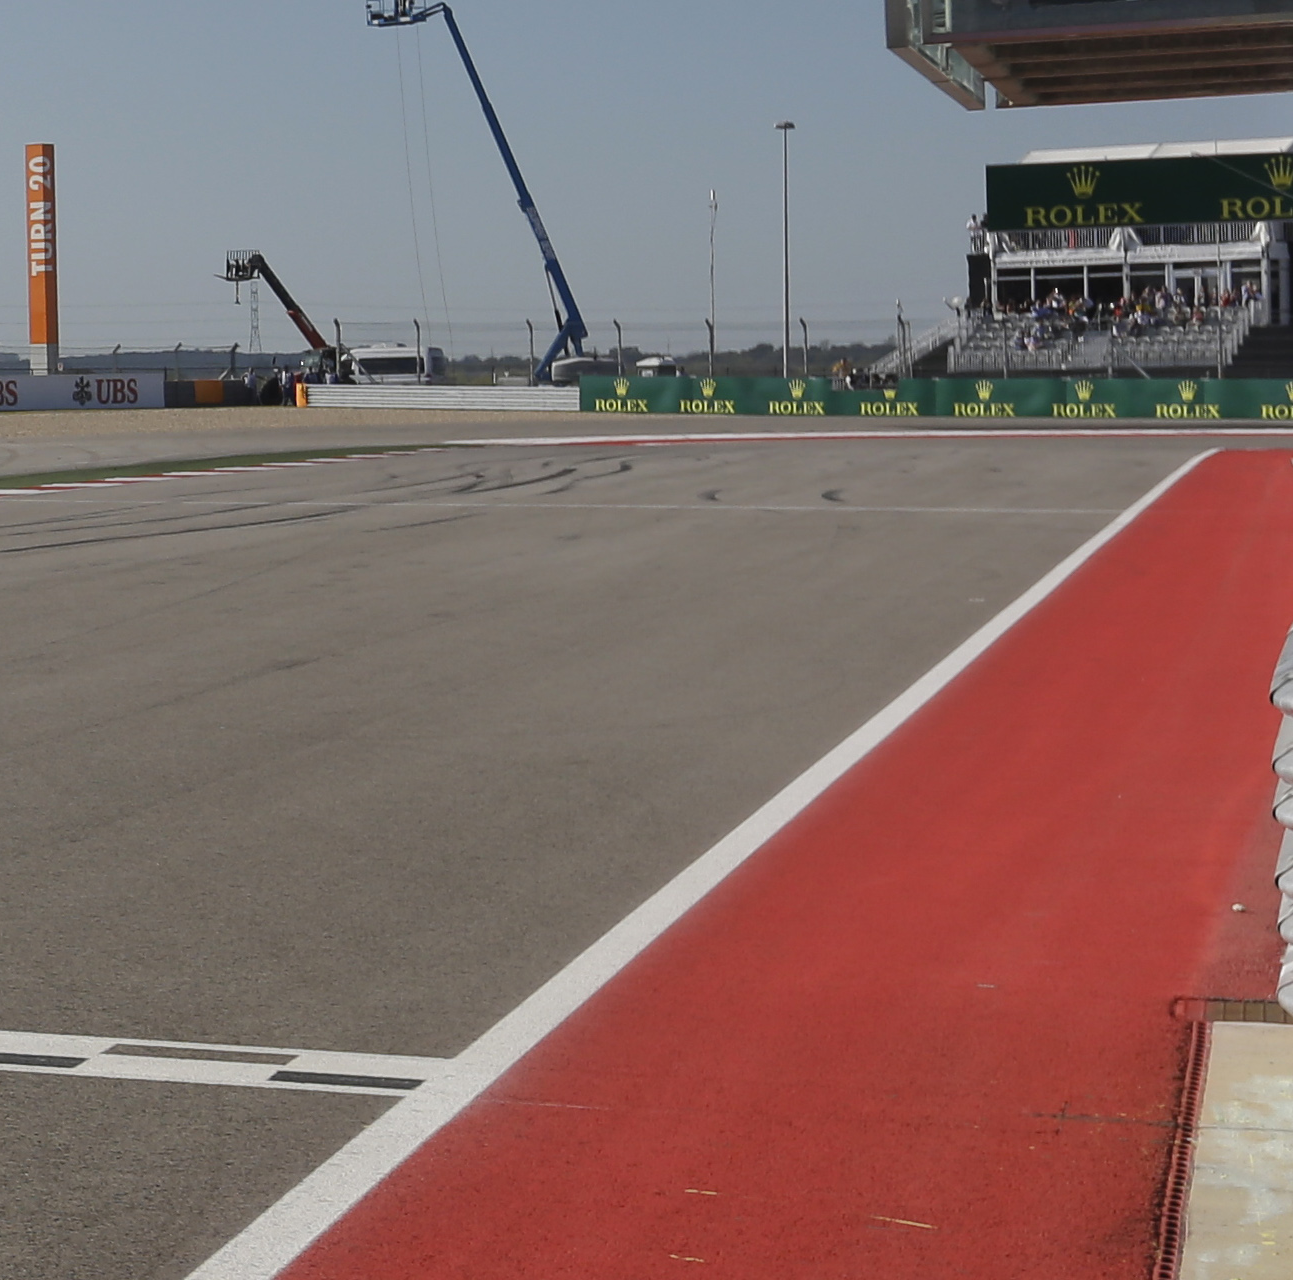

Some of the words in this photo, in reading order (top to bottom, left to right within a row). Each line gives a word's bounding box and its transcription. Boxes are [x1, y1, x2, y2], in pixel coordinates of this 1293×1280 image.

[28, 155, 52, 191] 20
[1023, 202, 1145, 228] ROLEX
[1219, 196, 1293, 221] ROL
[30, 201, 53, 277] TURN
[95, 378, 139, 405] UBS
[595, 399, 649, 413] ROLEX
[679, 399, 735, 414] ROLEX
[768, 400, 825, 415] ROLEX
[860, 401, 919, 416] ROLEX
[954, 402, 1015, 417] ROLEX
[1052, 403, 1117, 418] ROLEX
[1155, 403, 1221, 419] ROLEX
